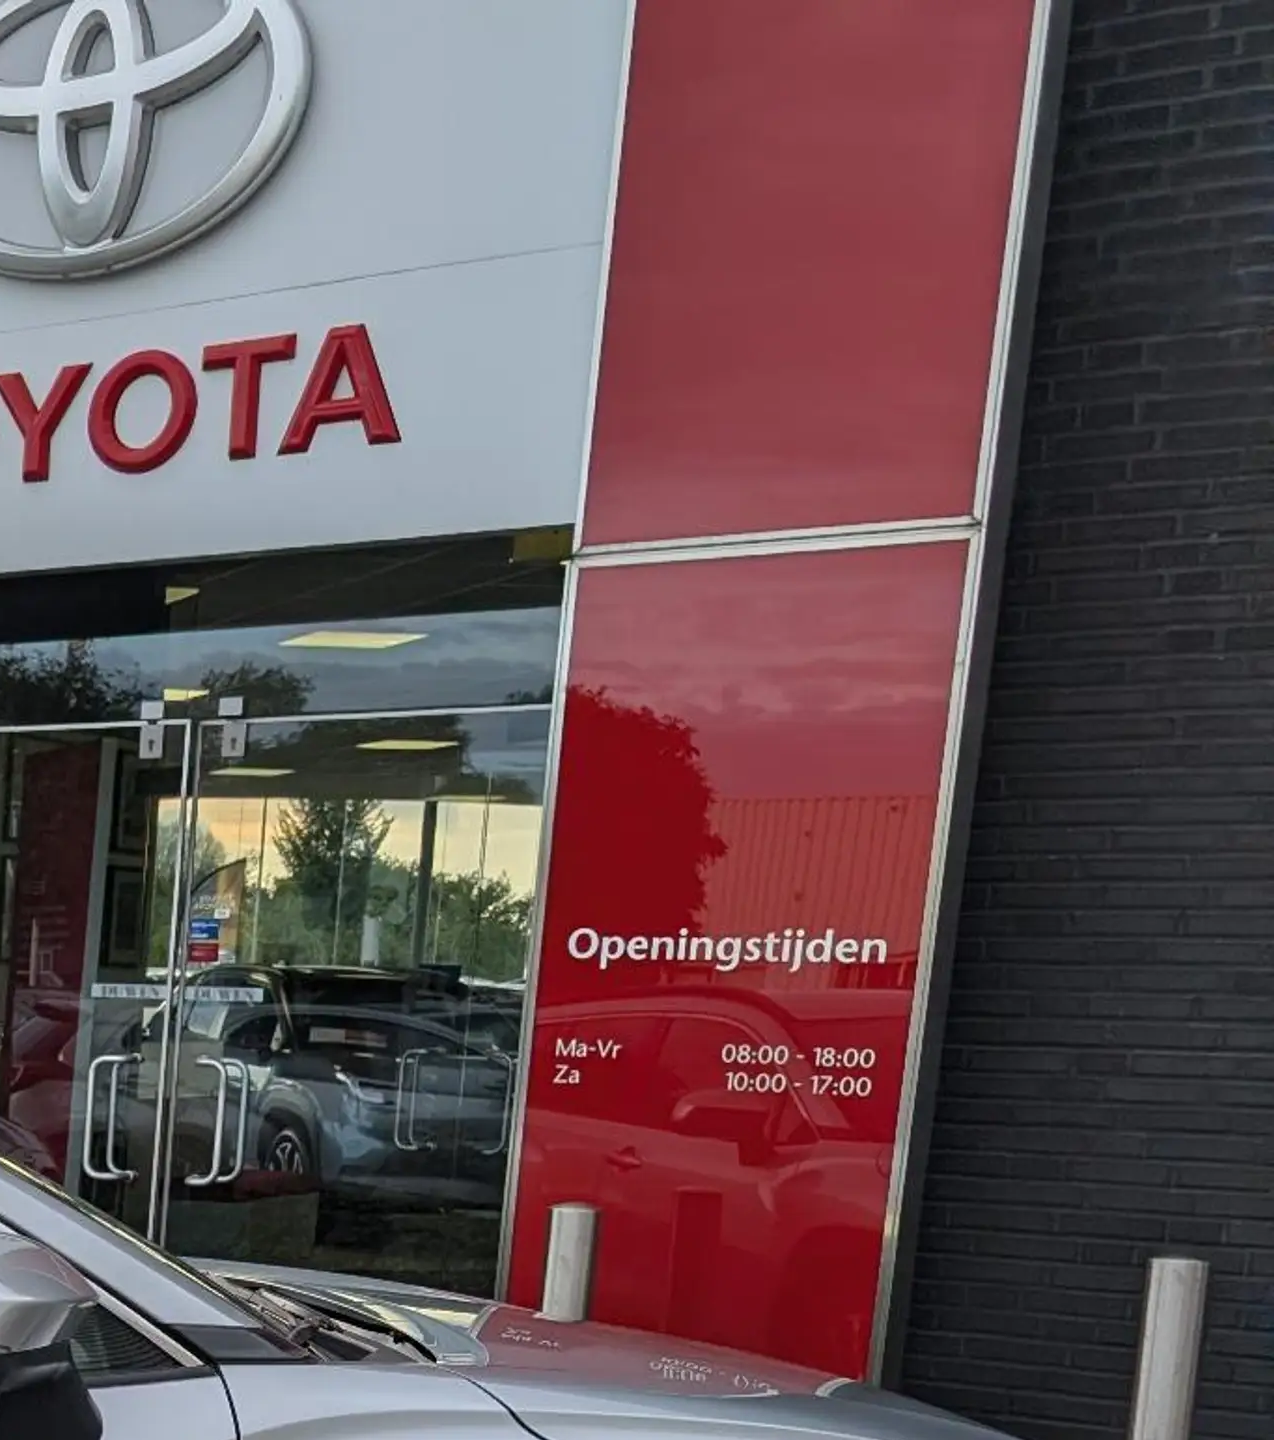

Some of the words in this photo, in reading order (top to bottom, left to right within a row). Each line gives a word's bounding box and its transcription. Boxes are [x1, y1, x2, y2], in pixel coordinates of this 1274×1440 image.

[567, 926, 888, 972] Openingstijden
[555, 1038, 622, 1060] Ma-Vr
[721, 1043, 790, 1067] 08:00
[813, 1046, 876, 1070] 18:00
[553, 1064, 581, 1085] Za
[725, 1072, 787, 1095] 10:00
[809, 1075, 872, 1098] 17:00
